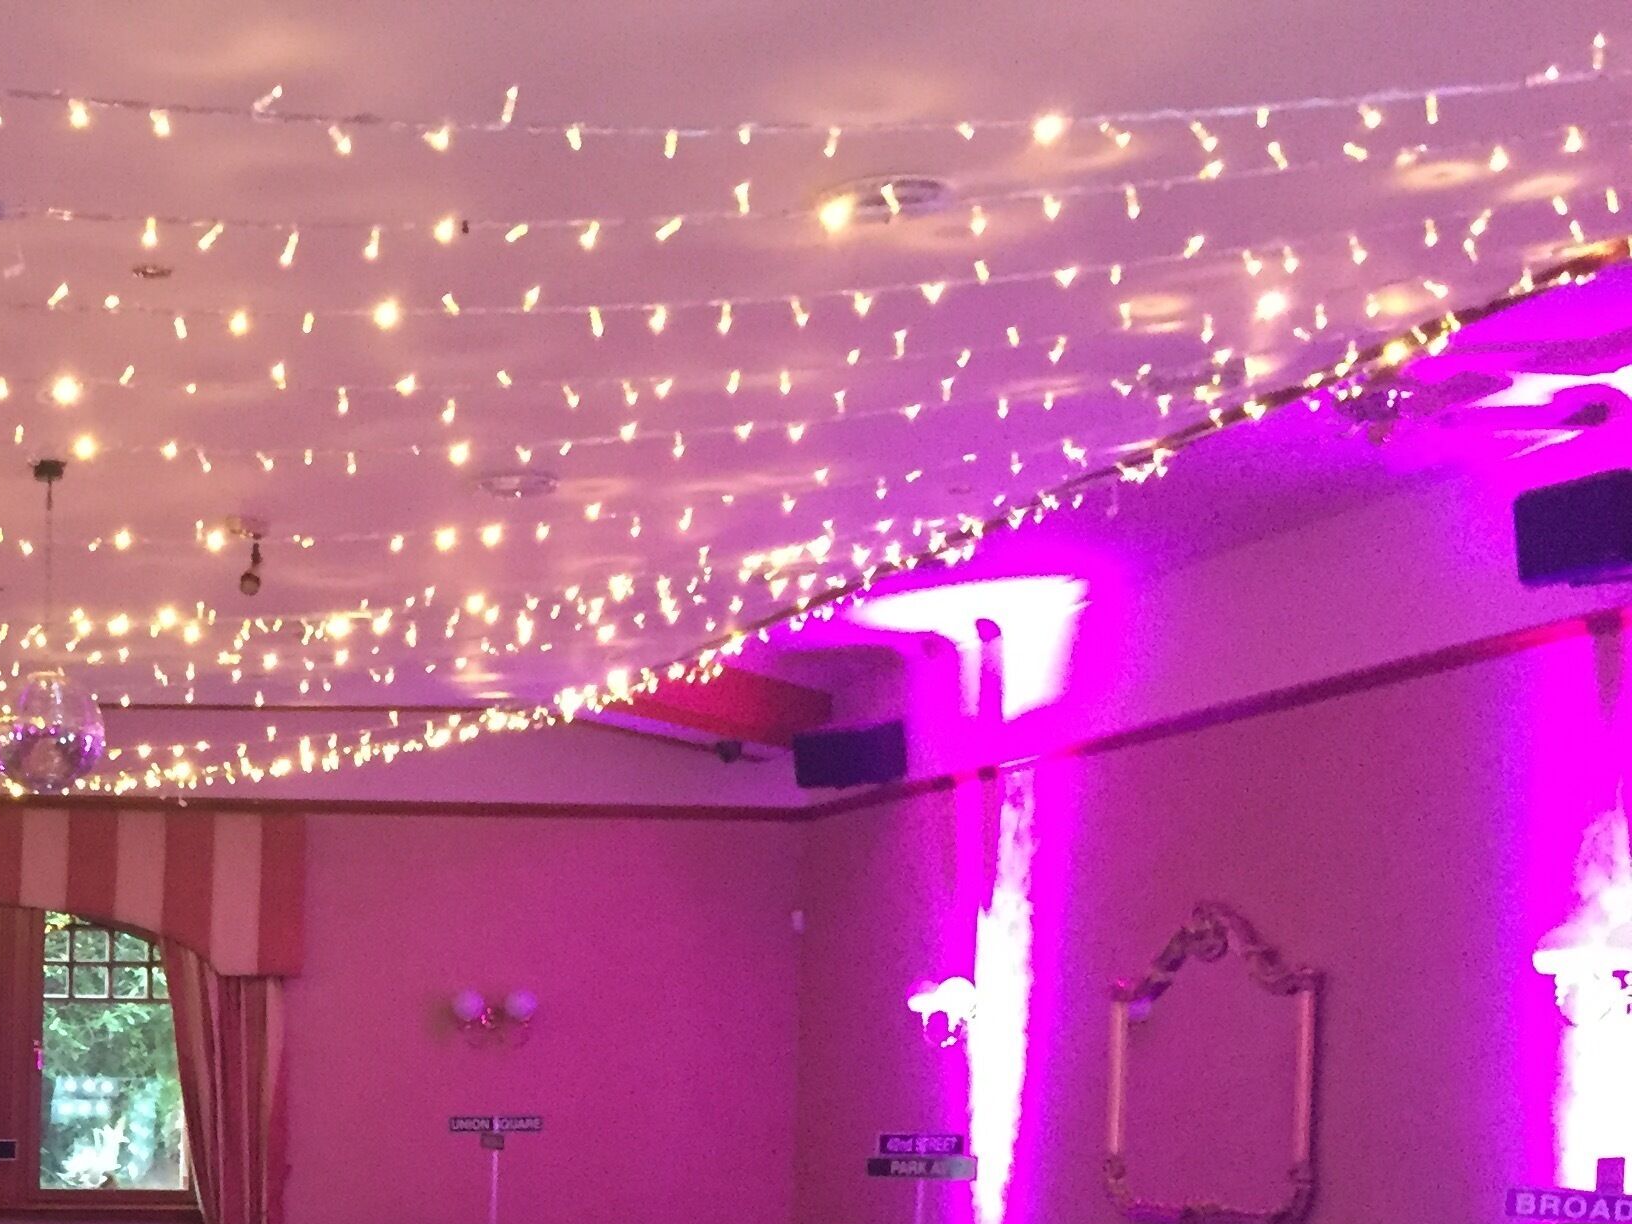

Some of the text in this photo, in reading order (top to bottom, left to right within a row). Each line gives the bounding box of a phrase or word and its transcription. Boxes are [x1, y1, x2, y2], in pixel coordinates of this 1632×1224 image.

[451, 1118, 490, 1130] UNION
[890, 1160, 928, 1175] PARK
[1515, 1192, 1632, 1221] BROAD
